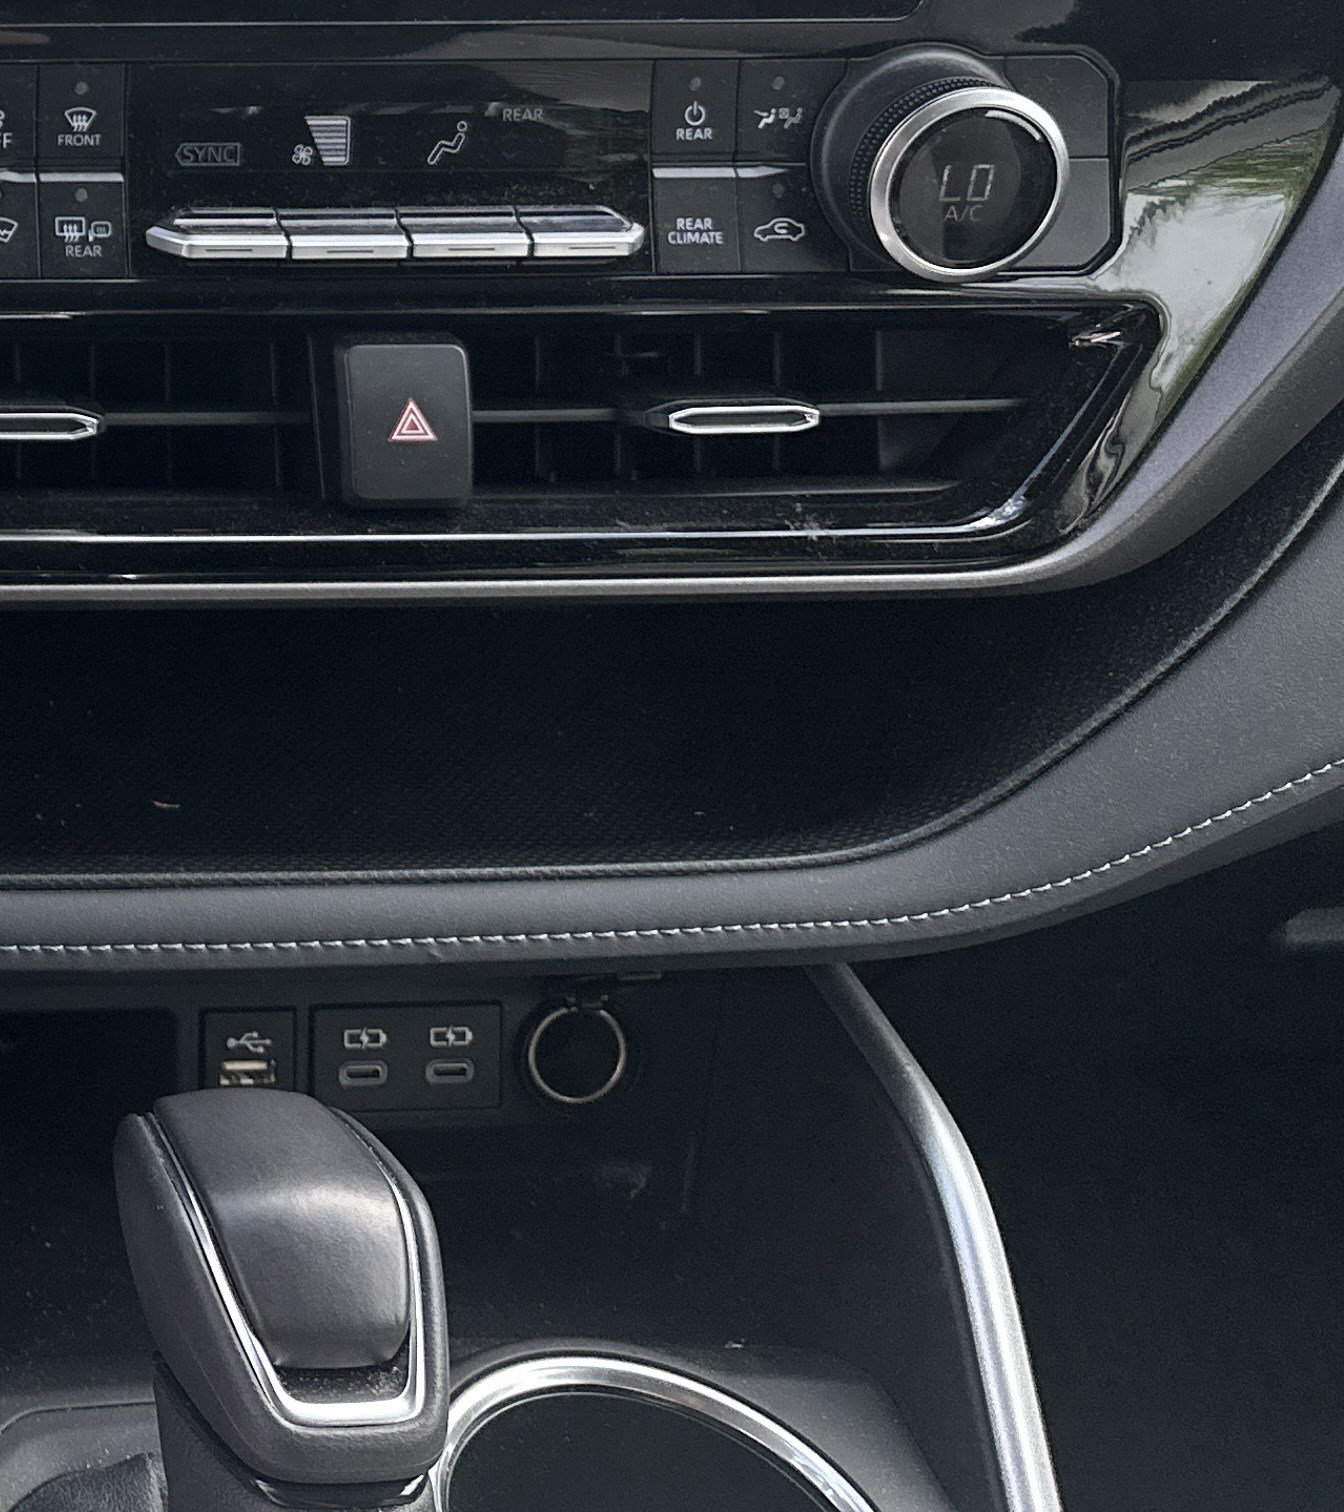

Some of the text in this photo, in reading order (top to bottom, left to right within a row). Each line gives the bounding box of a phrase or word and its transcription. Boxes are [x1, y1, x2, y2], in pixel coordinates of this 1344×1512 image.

[502, 107, 544, 122] REAR
[57, 133, 102, 147] FRONT
[676, 128, 714, 140] REAR
[182, 146, 236, 164] SYNC
[938, 164, 995, 202] LO
[944, 204, 984, 223] A/C
[676, 217, 713, 231] REAR
[667, 231, 724, 245] CLIMATE
[65, 244, 103, 258] REAR
